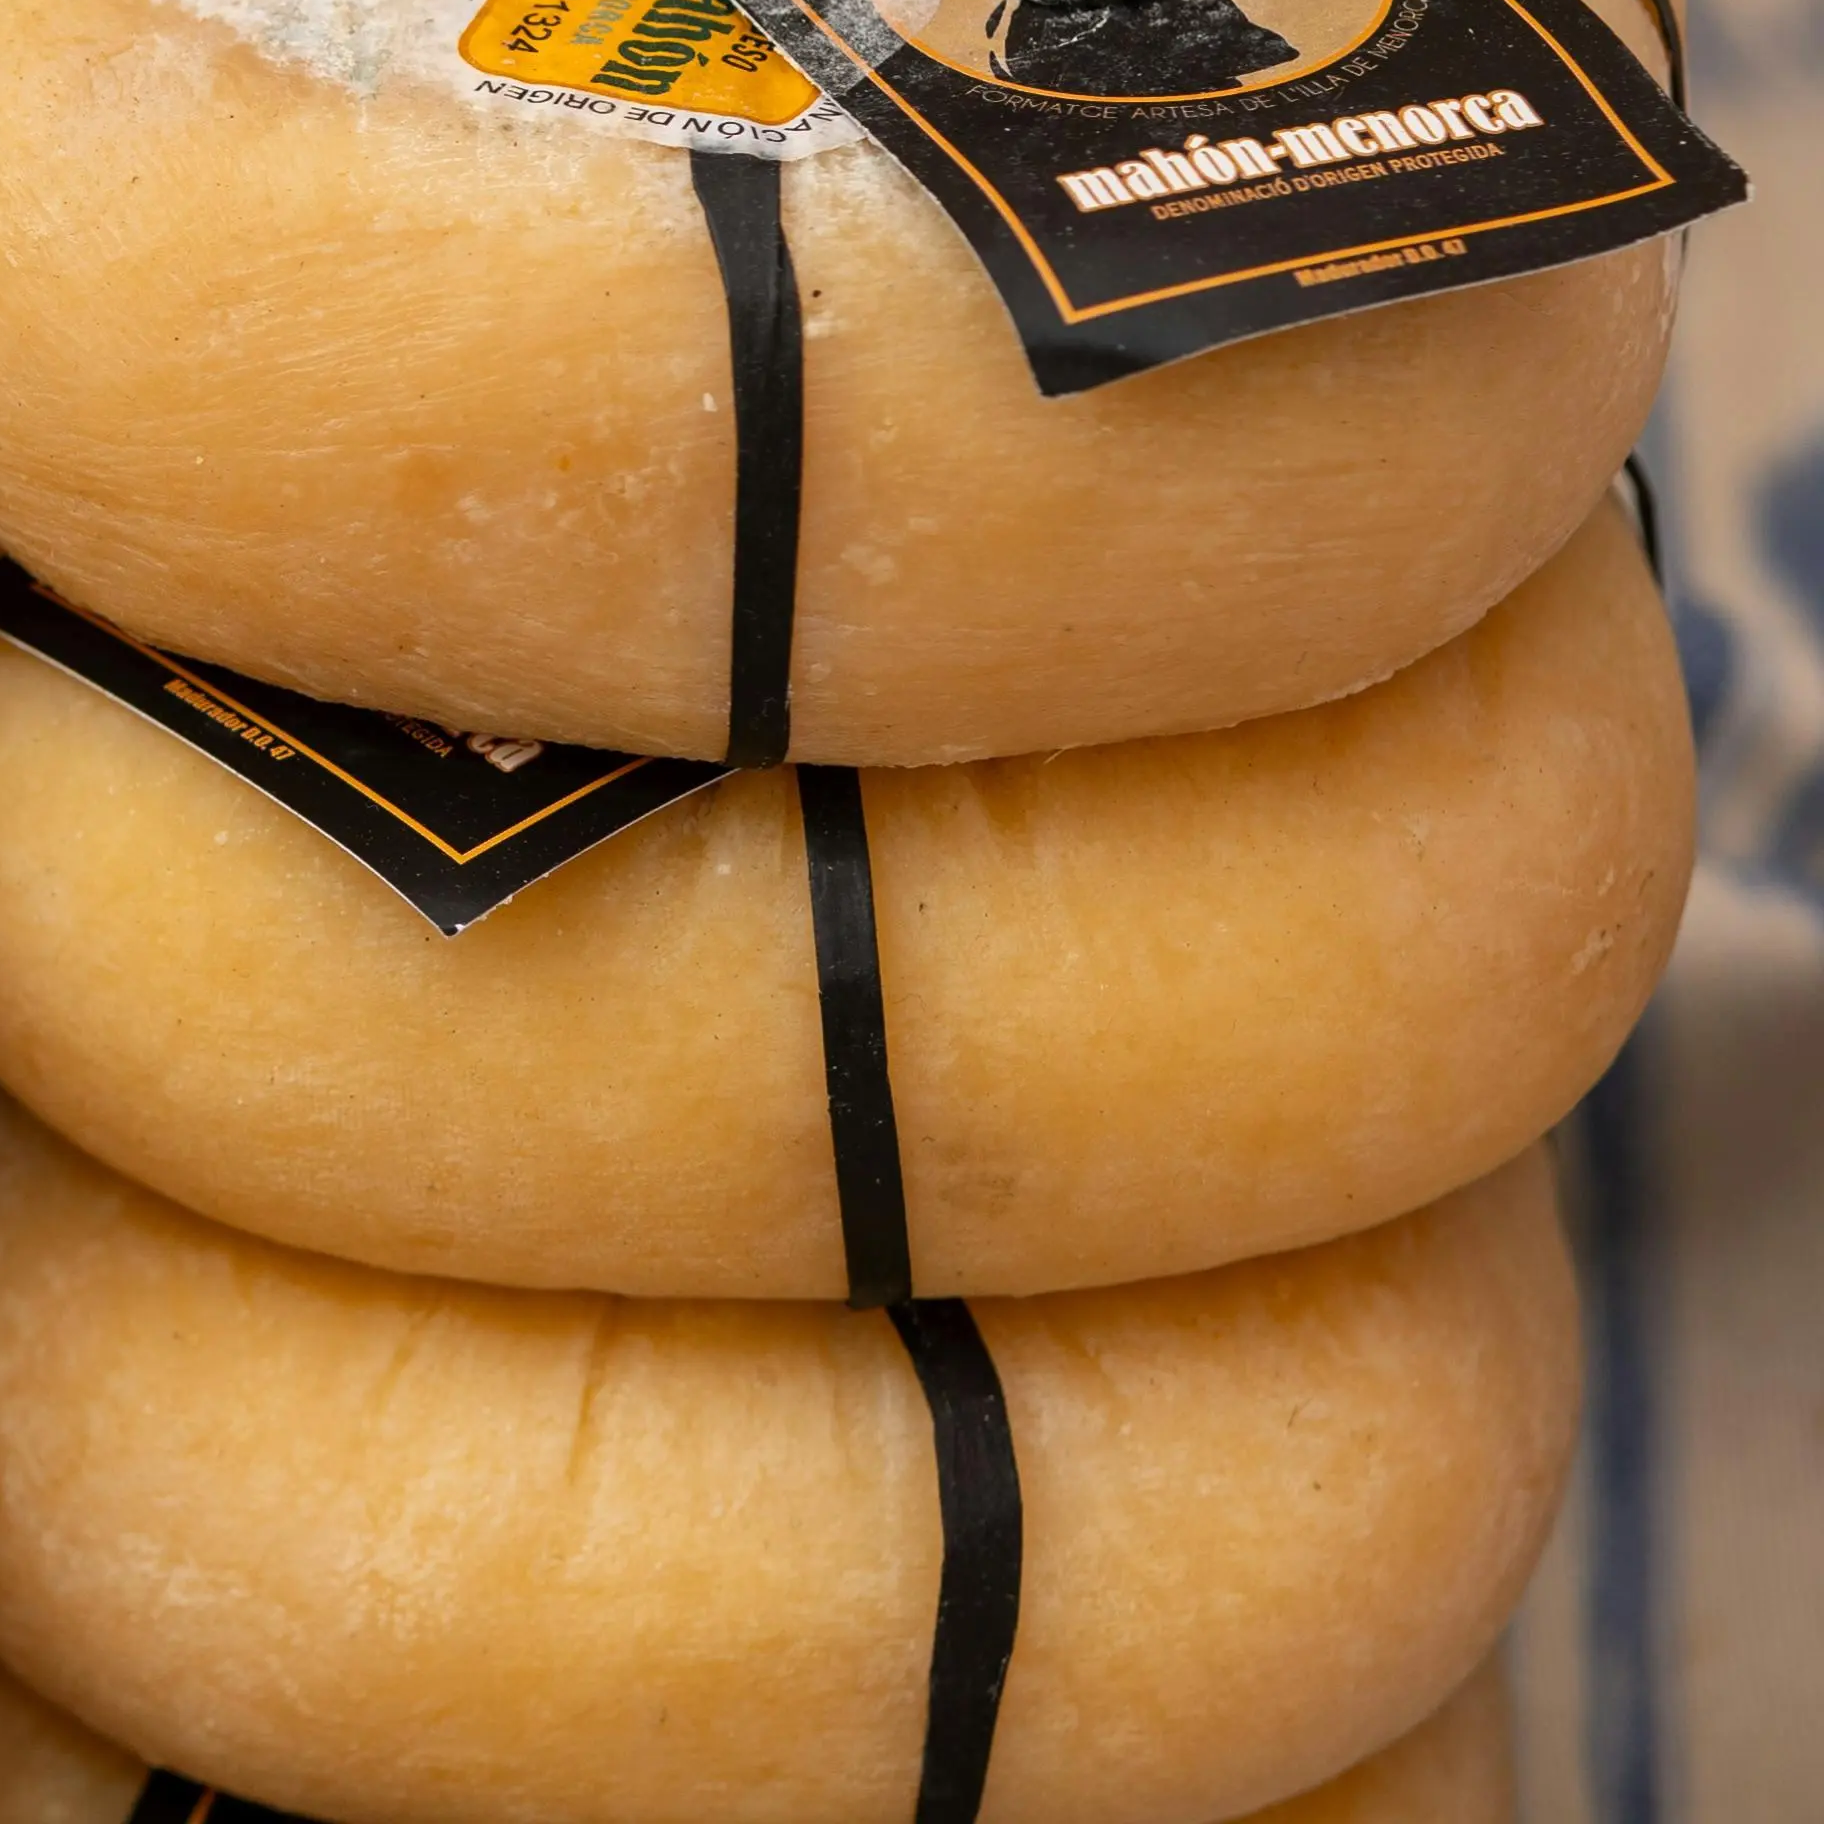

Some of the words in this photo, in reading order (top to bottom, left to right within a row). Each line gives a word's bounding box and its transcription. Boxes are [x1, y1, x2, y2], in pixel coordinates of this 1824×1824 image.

[721, 27, 777, 73] ESO
[473, 79, 618, 116] ORIGEN
[964, 83, 1119, 120] FORMATGE
[1245, 93, 1280, 113] DE
[1347, 55, 1377, 79] DE
[622, 106, 675, 128] DE
[1056, 88, 1545, 213] mahón-menorca
[1151, 176, 1293, 221] DENOMINACIÓ
[1291, 160, 1389, 193] D'ORIGEN
[1387, 141, 1505, 175] PROTEGIDA
